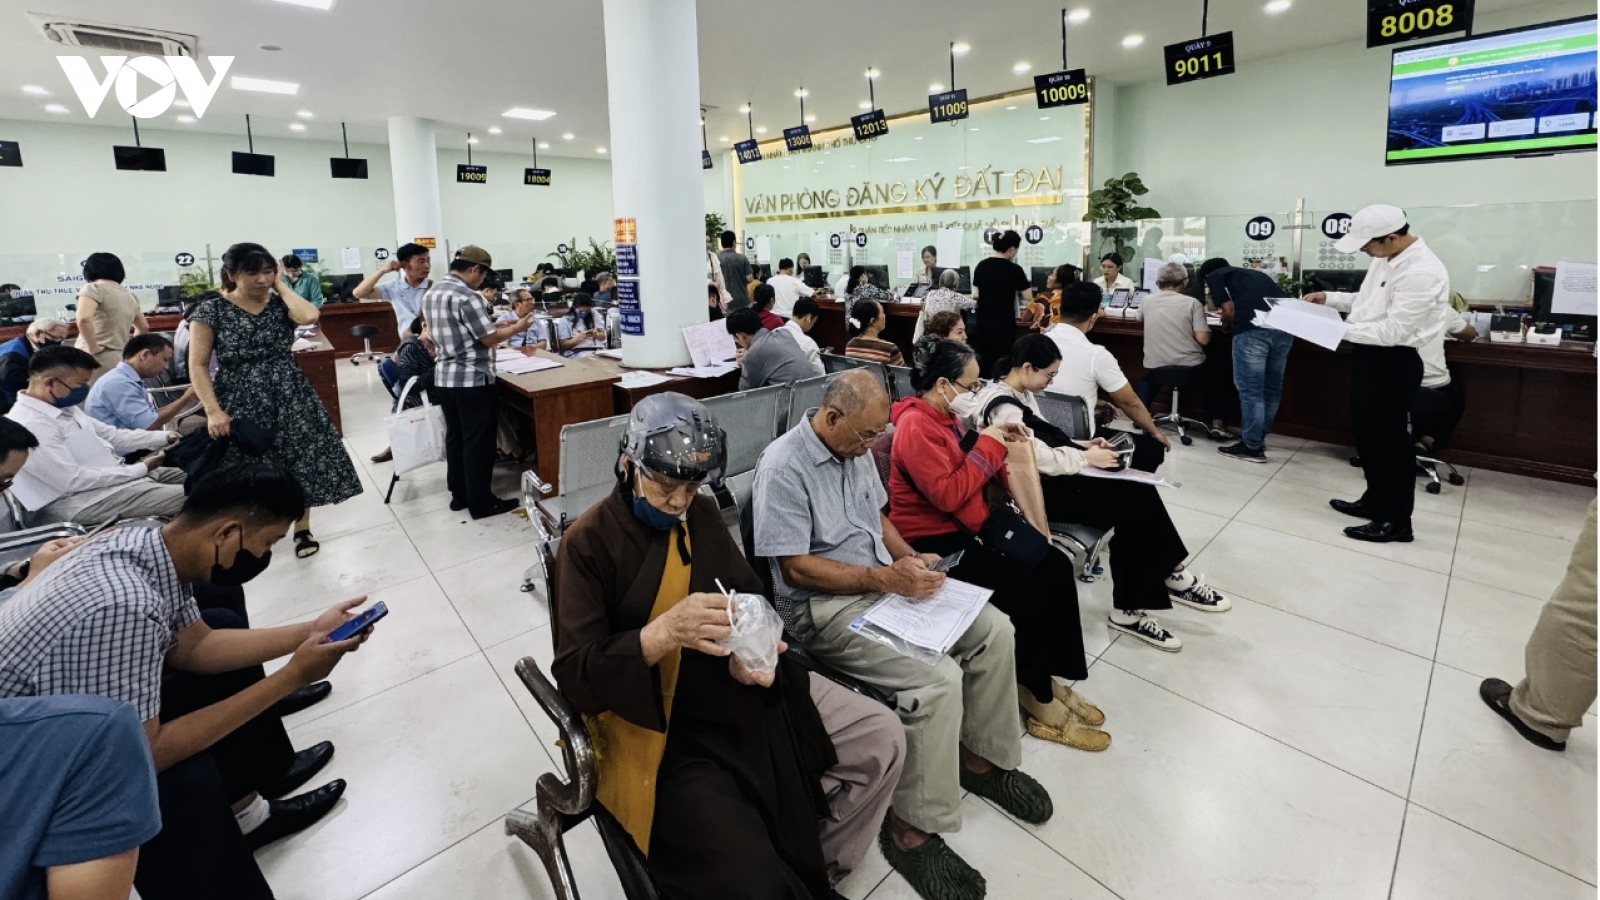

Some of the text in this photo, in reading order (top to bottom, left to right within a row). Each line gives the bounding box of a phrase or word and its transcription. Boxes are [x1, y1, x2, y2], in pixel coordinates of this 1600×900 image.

[1380, 4, 1454, 37] 8008
[1175, 51, 1223, 77] 9011
[1041, 83, 1086, 103] 10009
[933, 101, 967, 118] 11009
[856, 119, 887, 136] 12013
[460, 172, 487, 181] 19009
[780, 186, 841, 212] PHÒNG
[846, 180, 908, 207] ĐĂNG
[914, 171, 945, 201] KÝ
[954, 163, 1005, 198] ĐẤT
[1248, 221, 1272, 236] 09
[1325, 218, 1352, 234] 08
[857, 235, 866, 245] 12
[1028, 229, 1040, 241] 10
[177, 254, 193, 266] 22
[376, 250, 388, 259] 20
